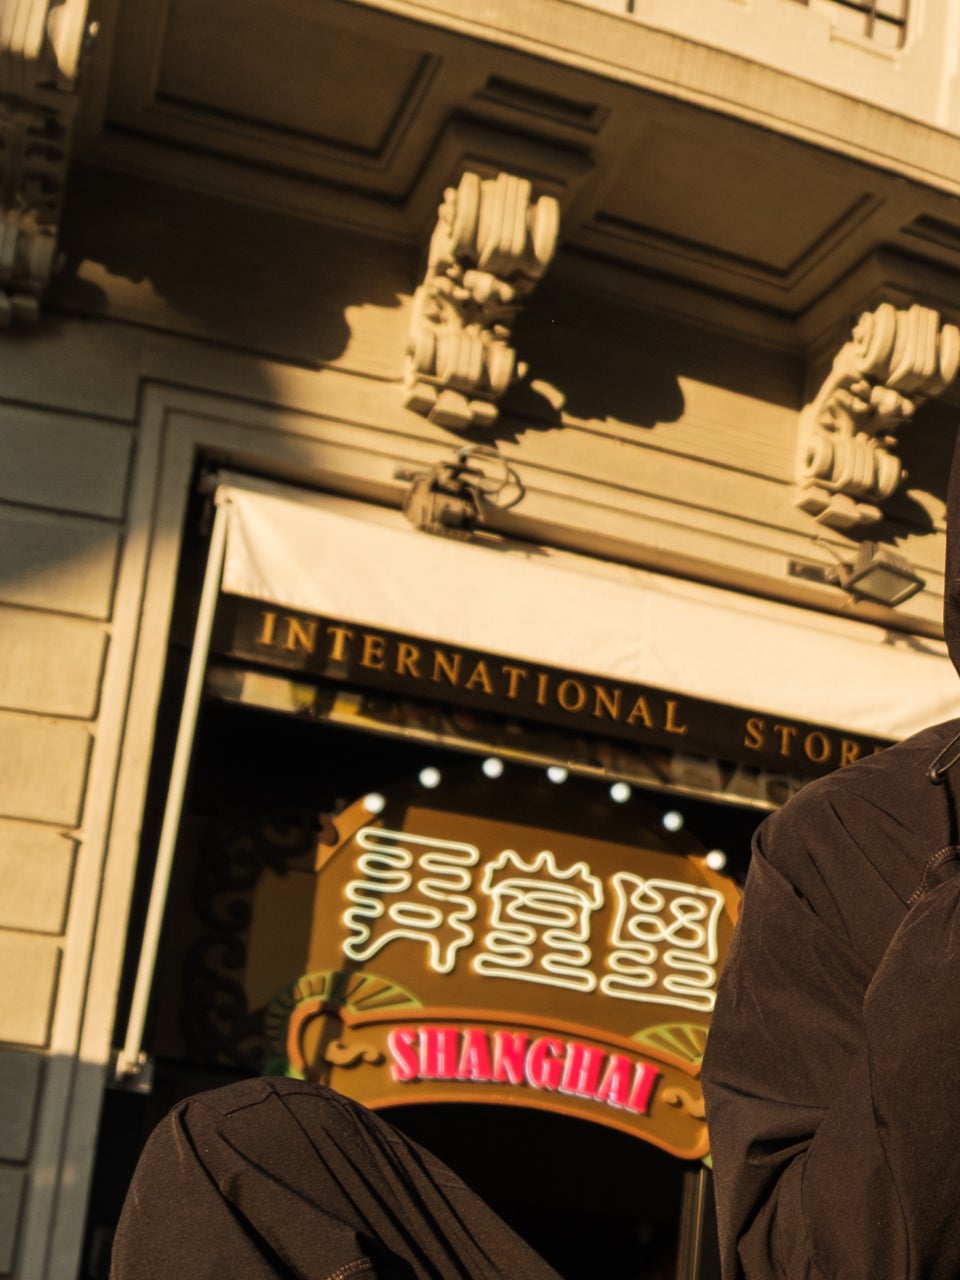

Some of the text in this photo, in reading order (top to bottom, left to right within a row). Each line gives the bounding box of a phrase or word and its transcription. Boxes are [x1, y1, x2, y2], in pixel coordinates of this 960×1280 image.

[257, 611, 886, 769] INTERNATIONAL STOR
[386, 1024, 661, 1115] SHANGHAI
